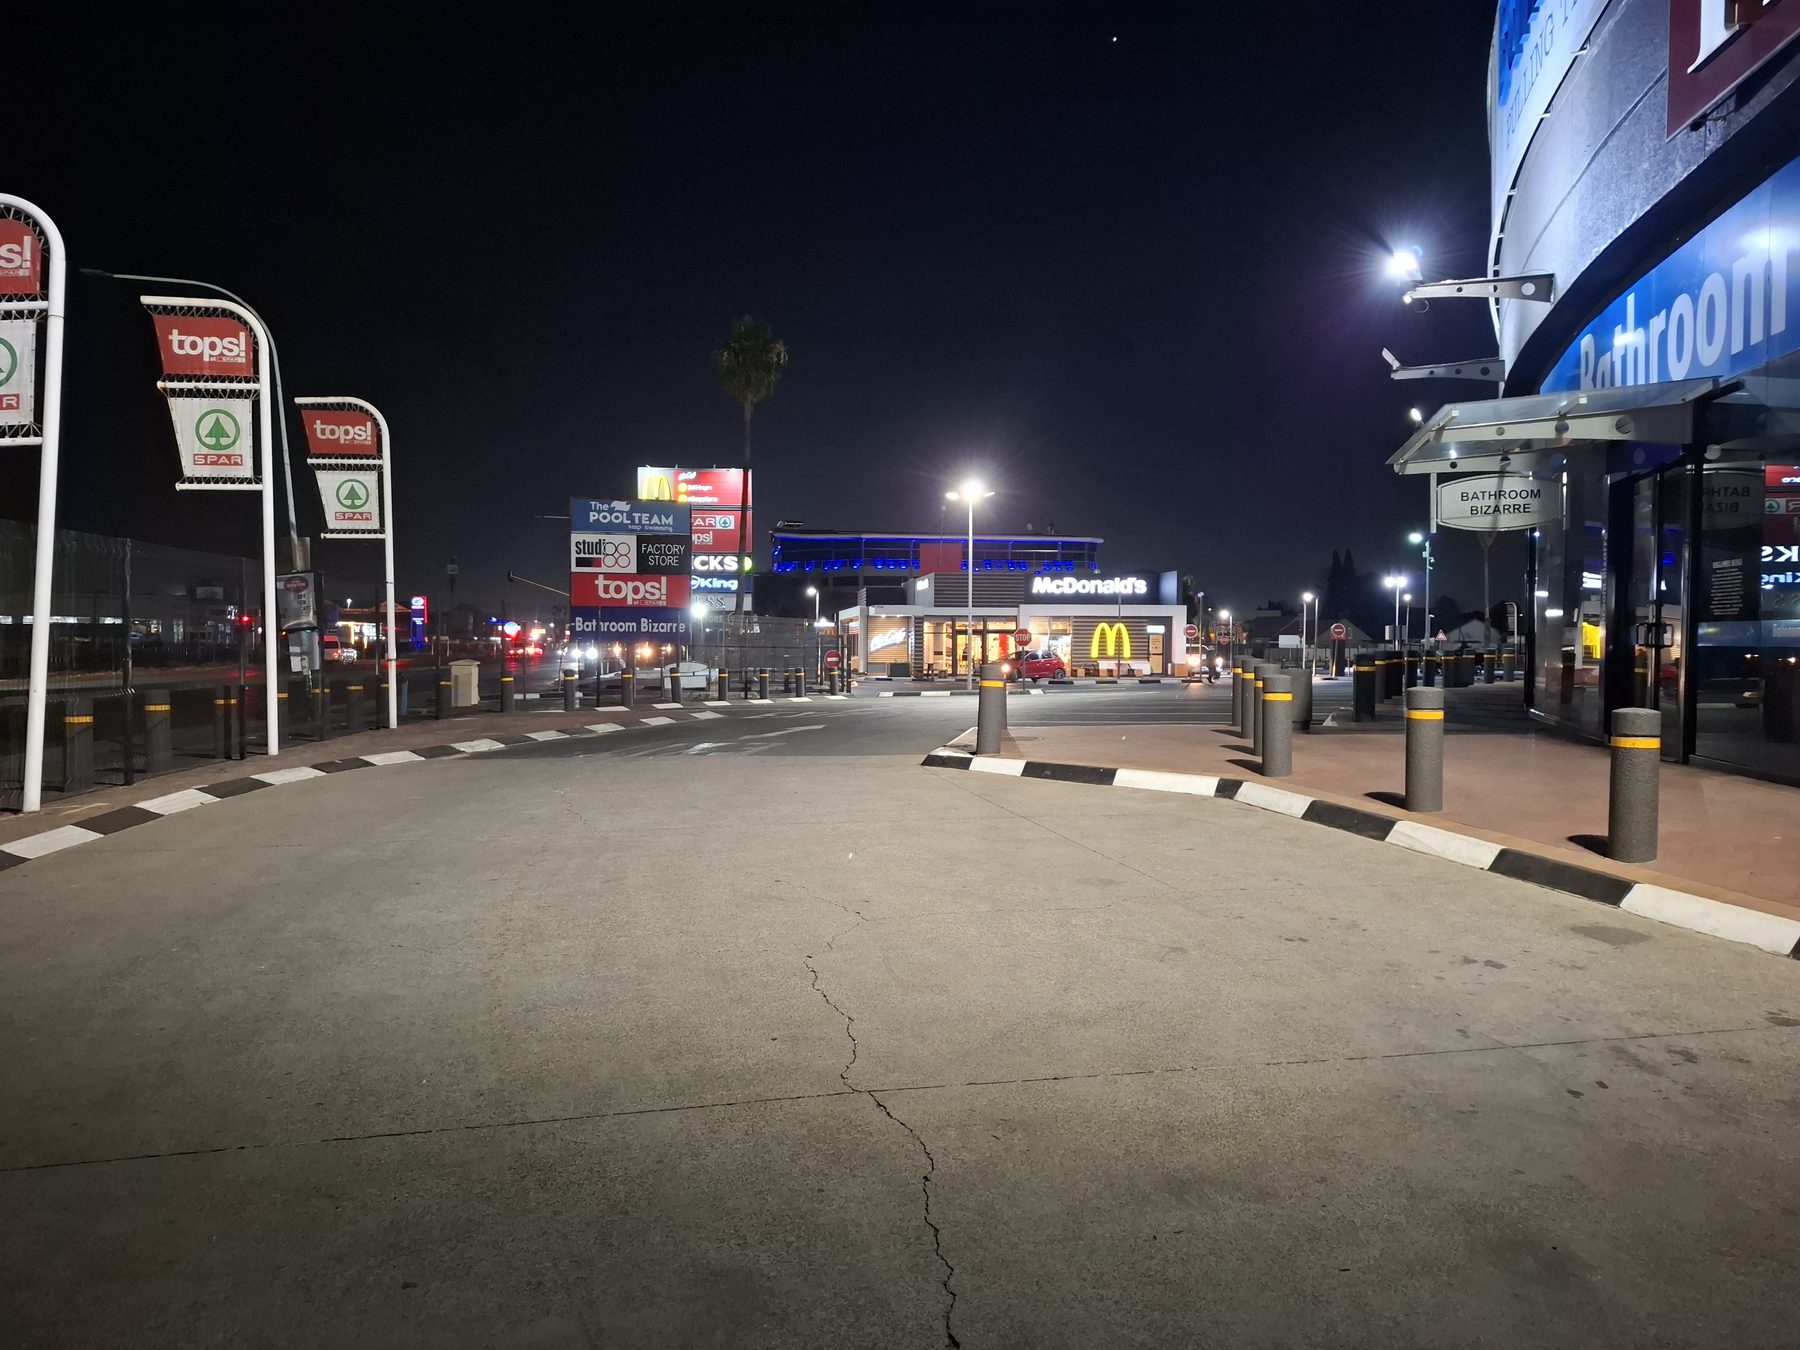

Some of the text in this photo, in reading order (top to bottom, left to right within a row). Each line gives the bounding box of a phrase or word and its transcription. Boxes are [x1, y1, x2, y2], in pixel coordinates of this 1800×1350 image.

[1580, 243, 1788, 391] Bathroom
[168, 328, 246, 362] tops!
[313, 419, 372, 444] tops!
[193, 454, 242, 465] SPAR
[1460, 489, 1541, 501] BATHROOM
[590, 501, 609, 510] The
[1470, 503, 1532, 515] BIZARRE
[335, 512, 372, 520] SPAR
[590, 511, 674, 525] POOL TEAM
[691, 517, 717, 527] AR
[641, 543, 686, 555] FACTORY
[648, 555, 680, 566] STORE
[594, 574, 667, 605] tops!
[1031, 576, 1148, 594] McDonald's
[640, 617, 686, 632] Bizarre
[1014, 632, 1031, 641] STOP
